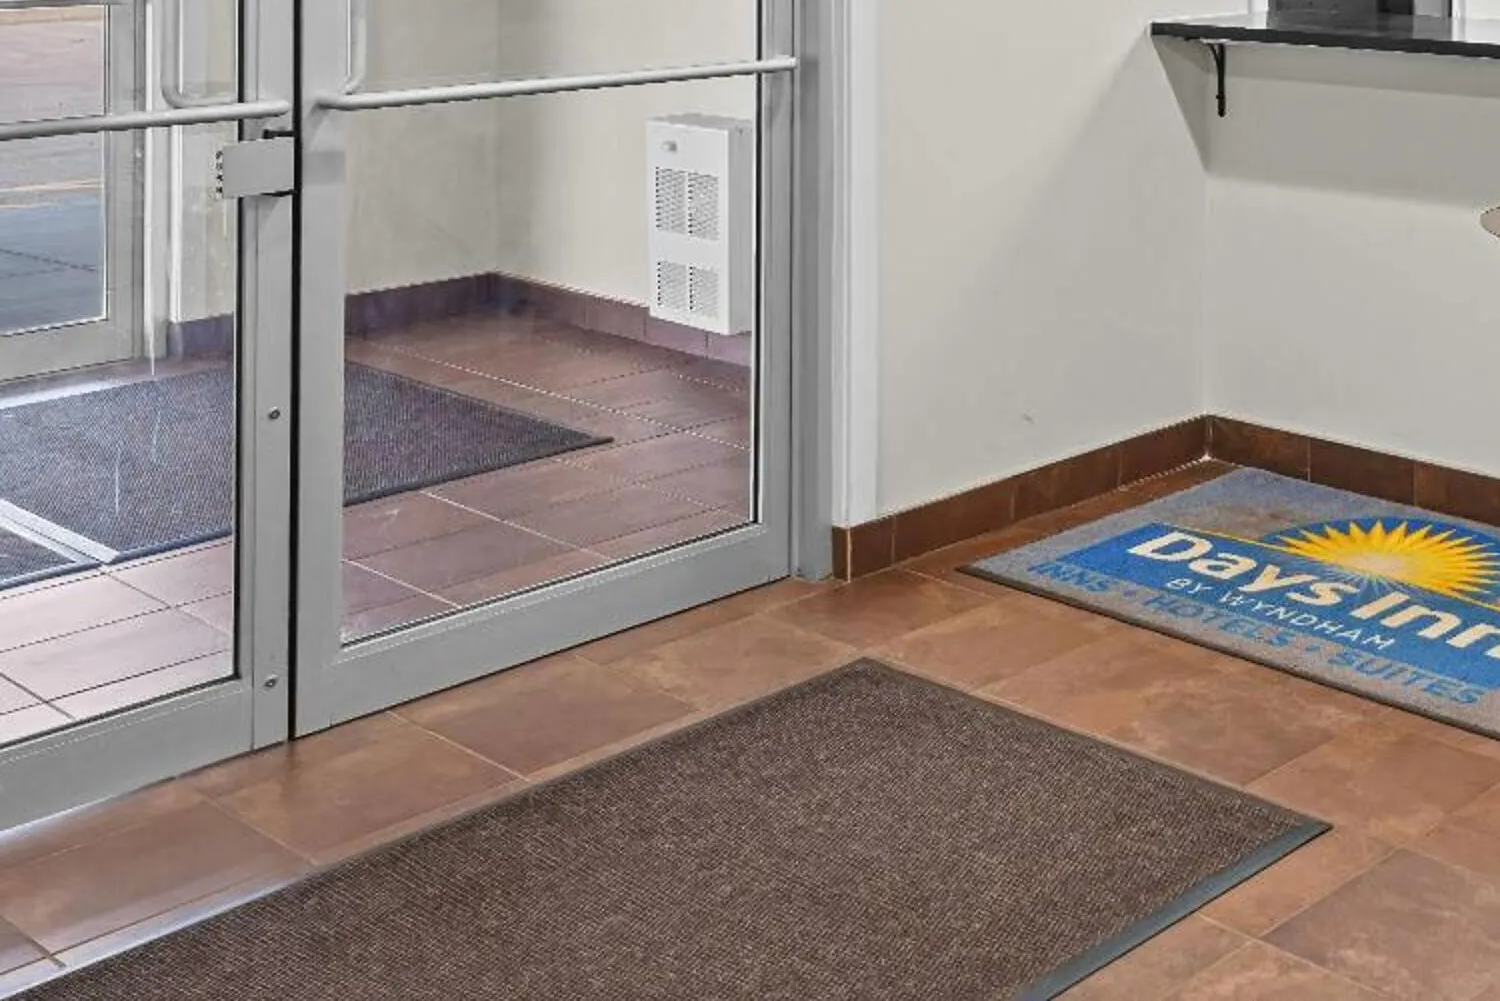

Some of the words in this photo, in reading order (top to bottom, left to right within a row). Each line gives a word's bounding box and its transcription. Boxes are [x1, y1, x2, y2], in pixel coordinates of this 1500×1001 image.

[1126, 531, 1360, 607] Days
[1165, 577, 1212, 596] BY
[1218, 590, 1397, 650] WYNDHAM
[1326, 650, 1486, 705] SUITES
